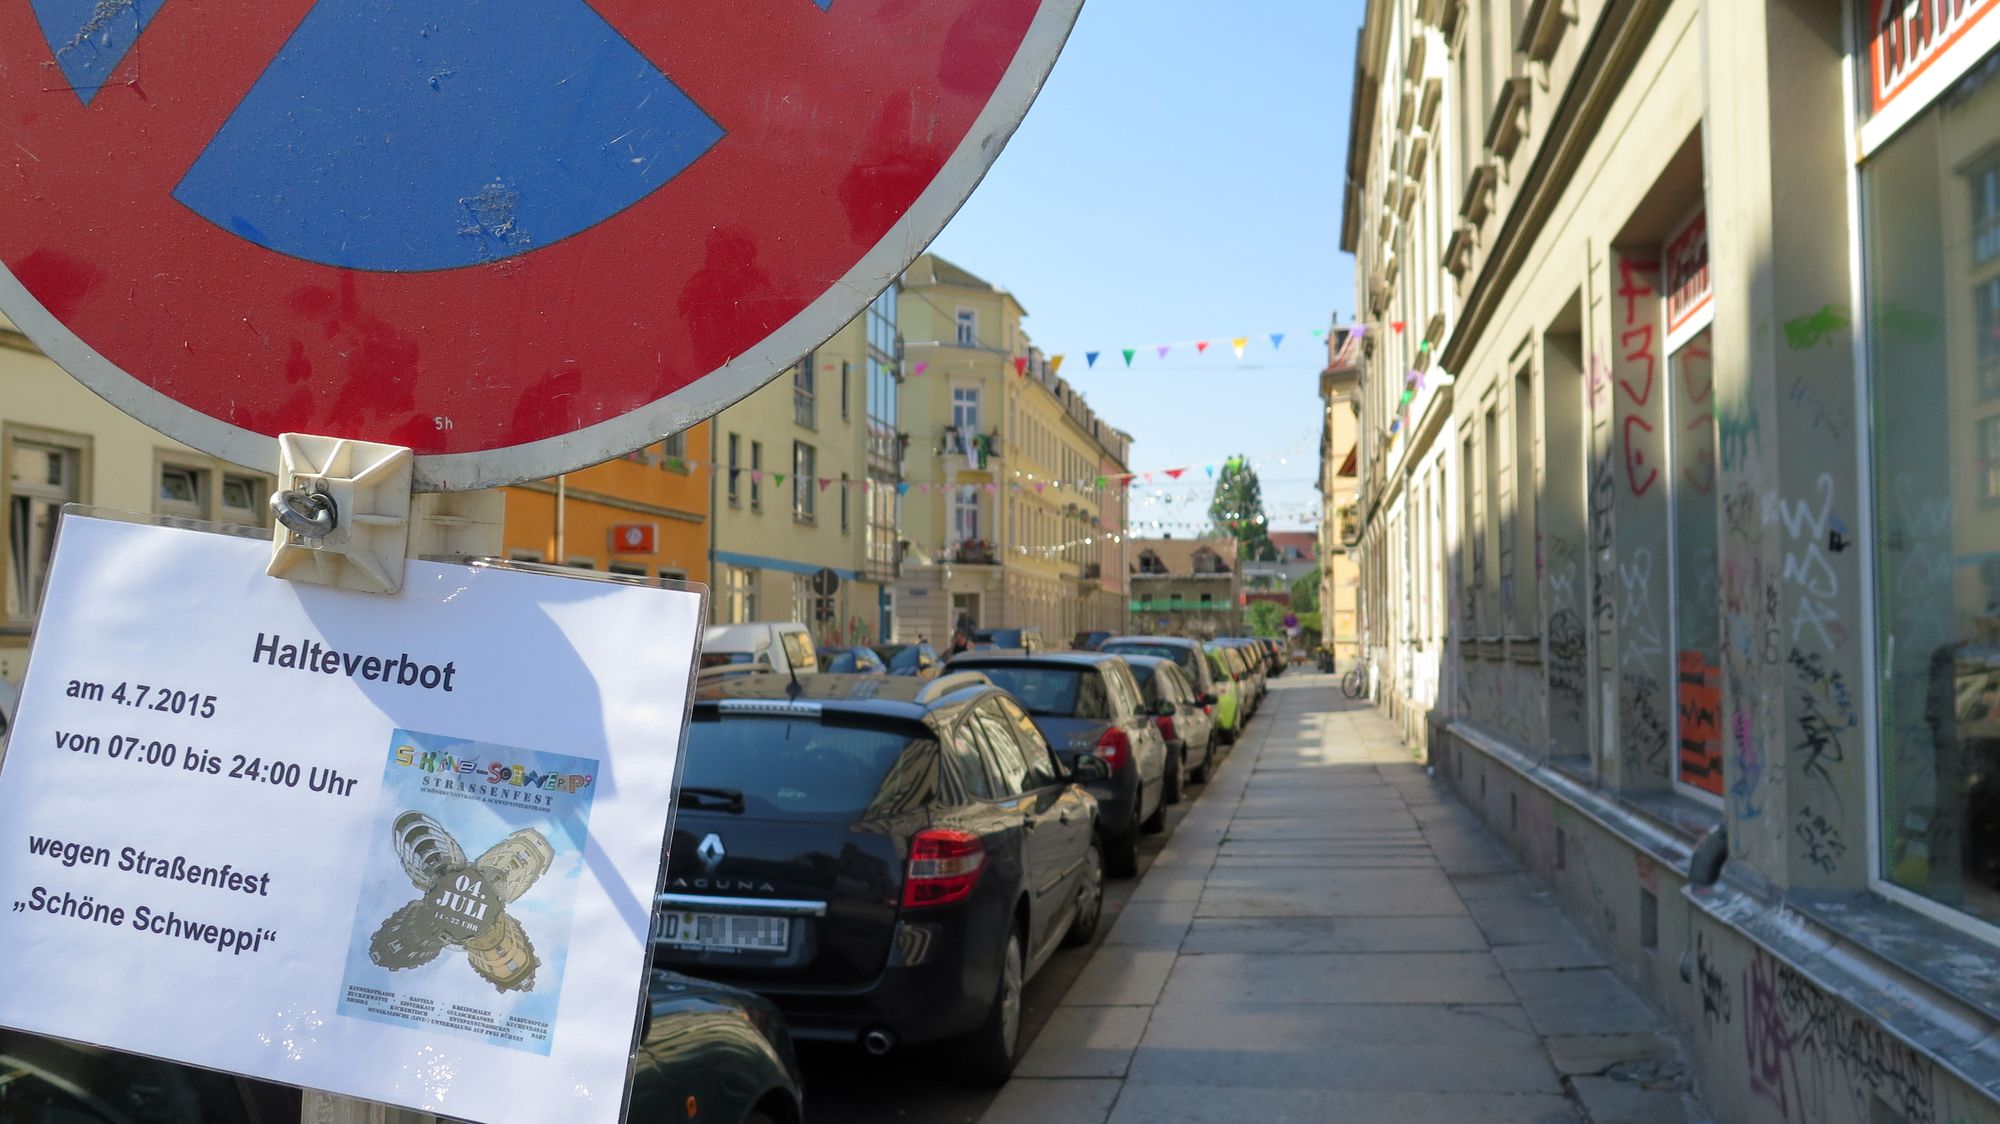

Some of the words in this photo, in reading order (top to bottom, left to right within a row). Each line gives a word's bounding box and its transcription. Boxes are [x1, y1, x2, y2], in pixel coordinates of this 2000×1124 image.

[253, 633, 455, 691] Halteverbot
[67, 680, 104, 701] am
[111, 682, 217, 718] 4.7.2015
[56, 731, 100, 754] von
[108, 735, 176, 766] 07:00
[183, 747, 221, 774] bis
[228, 755, 300, 787] 24:00
[309, 767, 358, 796] Uhr
[422, 776, 554, 806] STRASSENFEST
[29, 836, 110, 867] wegen
[118, 847, 270, 896] Straßenfest
[436, 891, 488, 920] JULI
[455, 875, 486, 899] 04.
[13, 887, 124, 926] „Schöne
[133, 906, 276, 955] Schweppi“
[451, 917, 460, 925] 22
[462, 921, 479, 932] UHR
